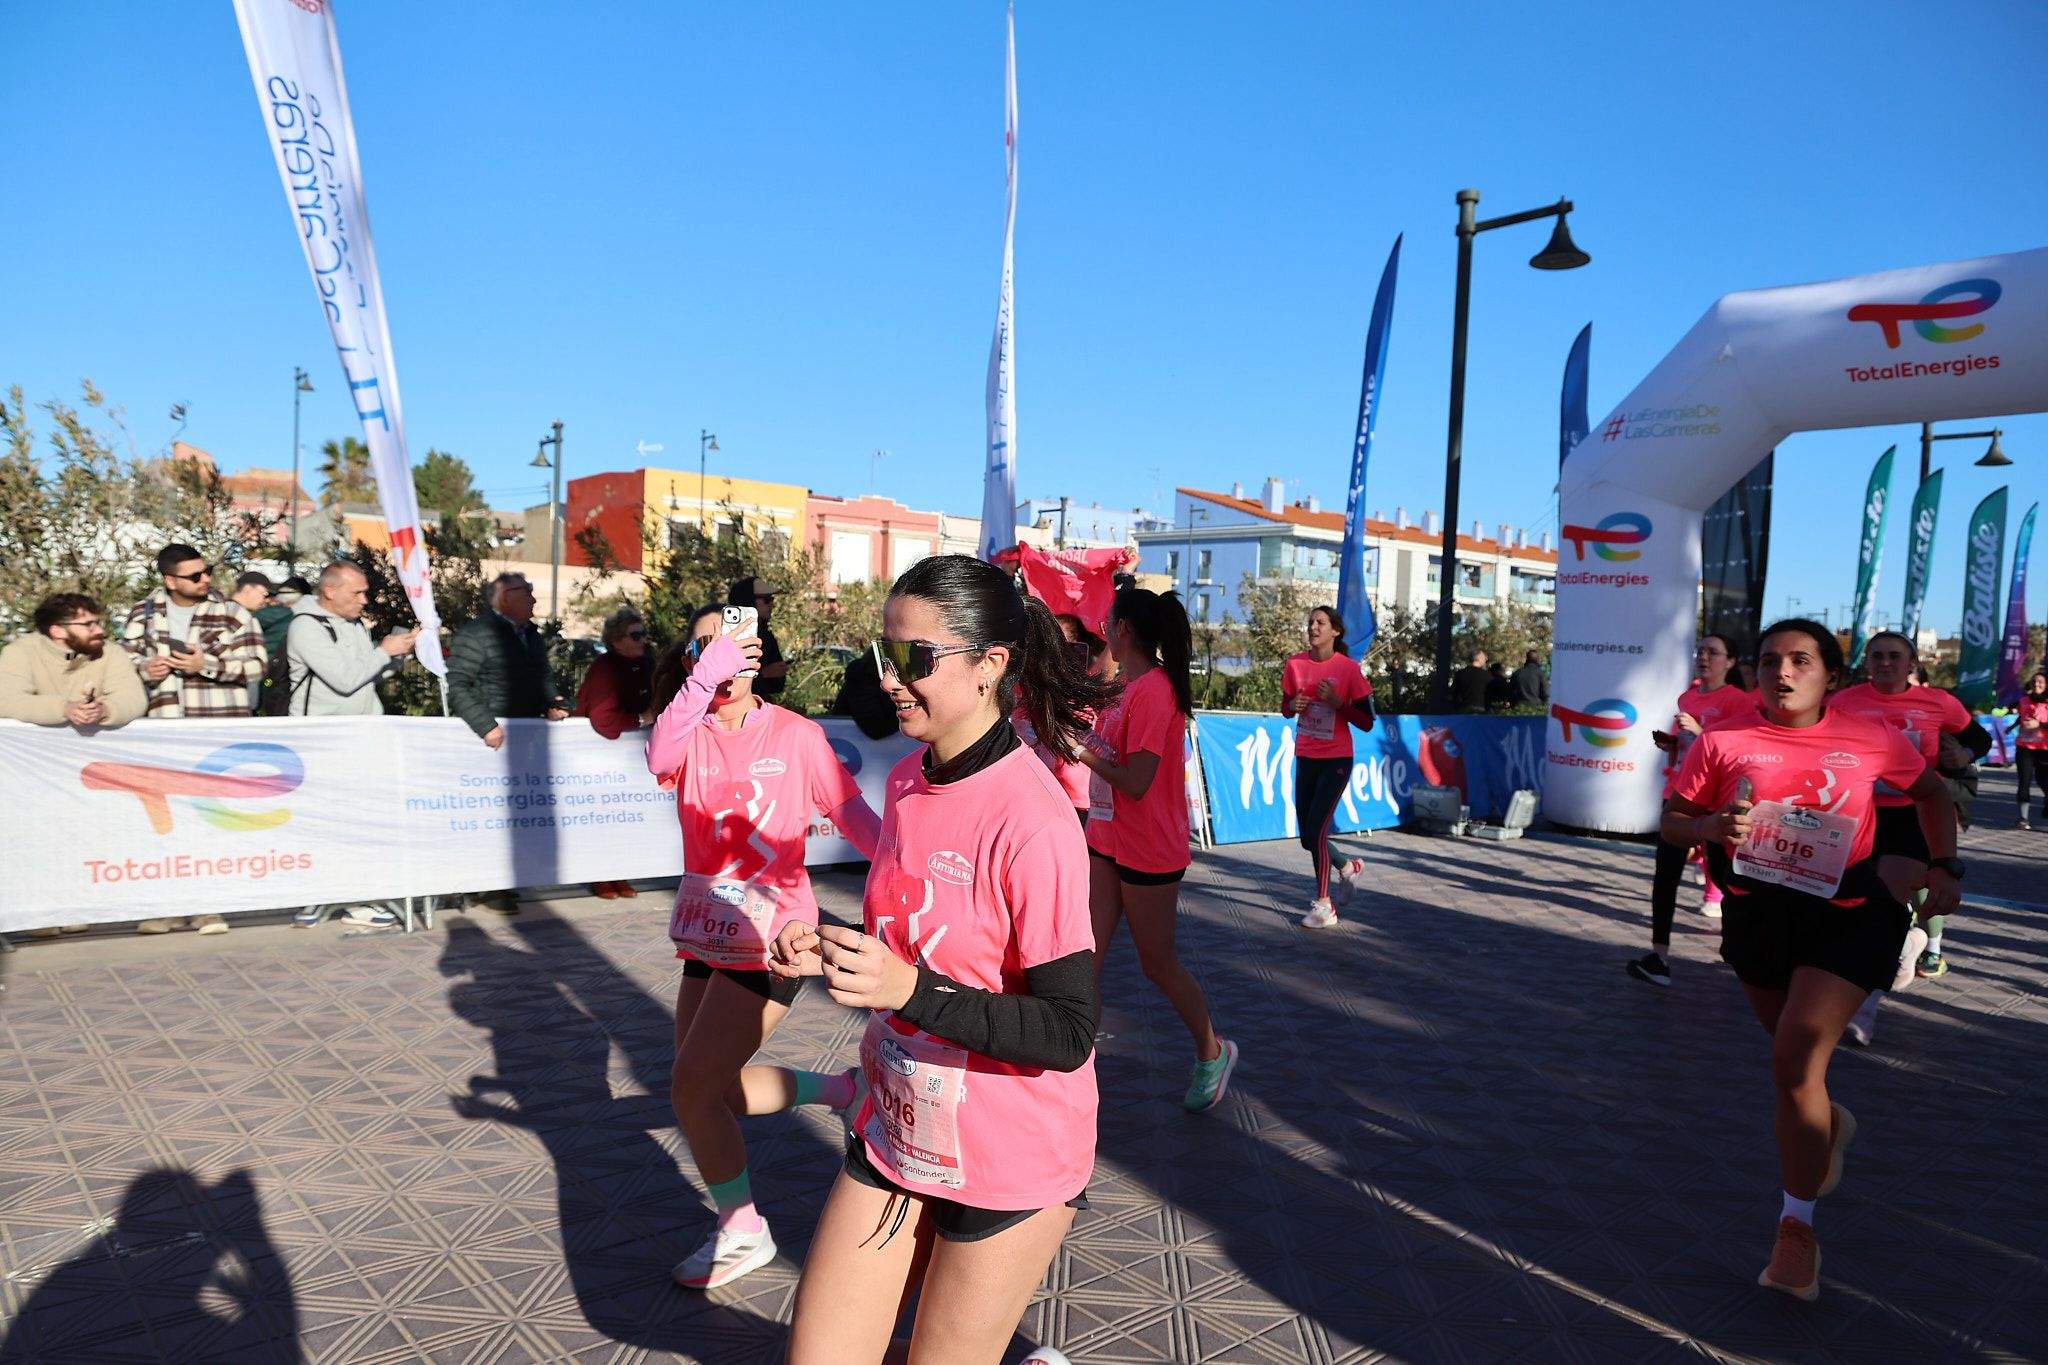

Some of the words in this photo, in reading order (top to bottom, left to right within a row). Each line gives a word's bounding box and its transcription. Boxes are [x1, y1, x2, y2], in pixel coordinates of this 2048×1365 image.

[1846, 354, 2001, 383] TotalEnergies
[1560, 572, 1650, 588] TotalEnergies
[1548, 750, 1635, 773] TotalEnergies
[459, 773, 520, 788] Somos
[525, 772, 540, 787] la
[546, 770, 627, 788] compañía
[405, 788, 557, 811] multienergías
[565, 793, 595, 806] que
[601, 789, 677, 804] patrocina
[450, 817, 477, 832] tus
[484, 814, 555, 830] carreras
[561, 810, 645, 828] preferidas
[1774, 838, 1815, 860] 016
[84, 847, 314, 884] TotalEnergies
[703, 918, 740, 937] 016
[882, 1089, 915, 1127] 016
[911, 1148, 940, 1164] VALENCIA
[904, 1162, 946, 1179] Santander
